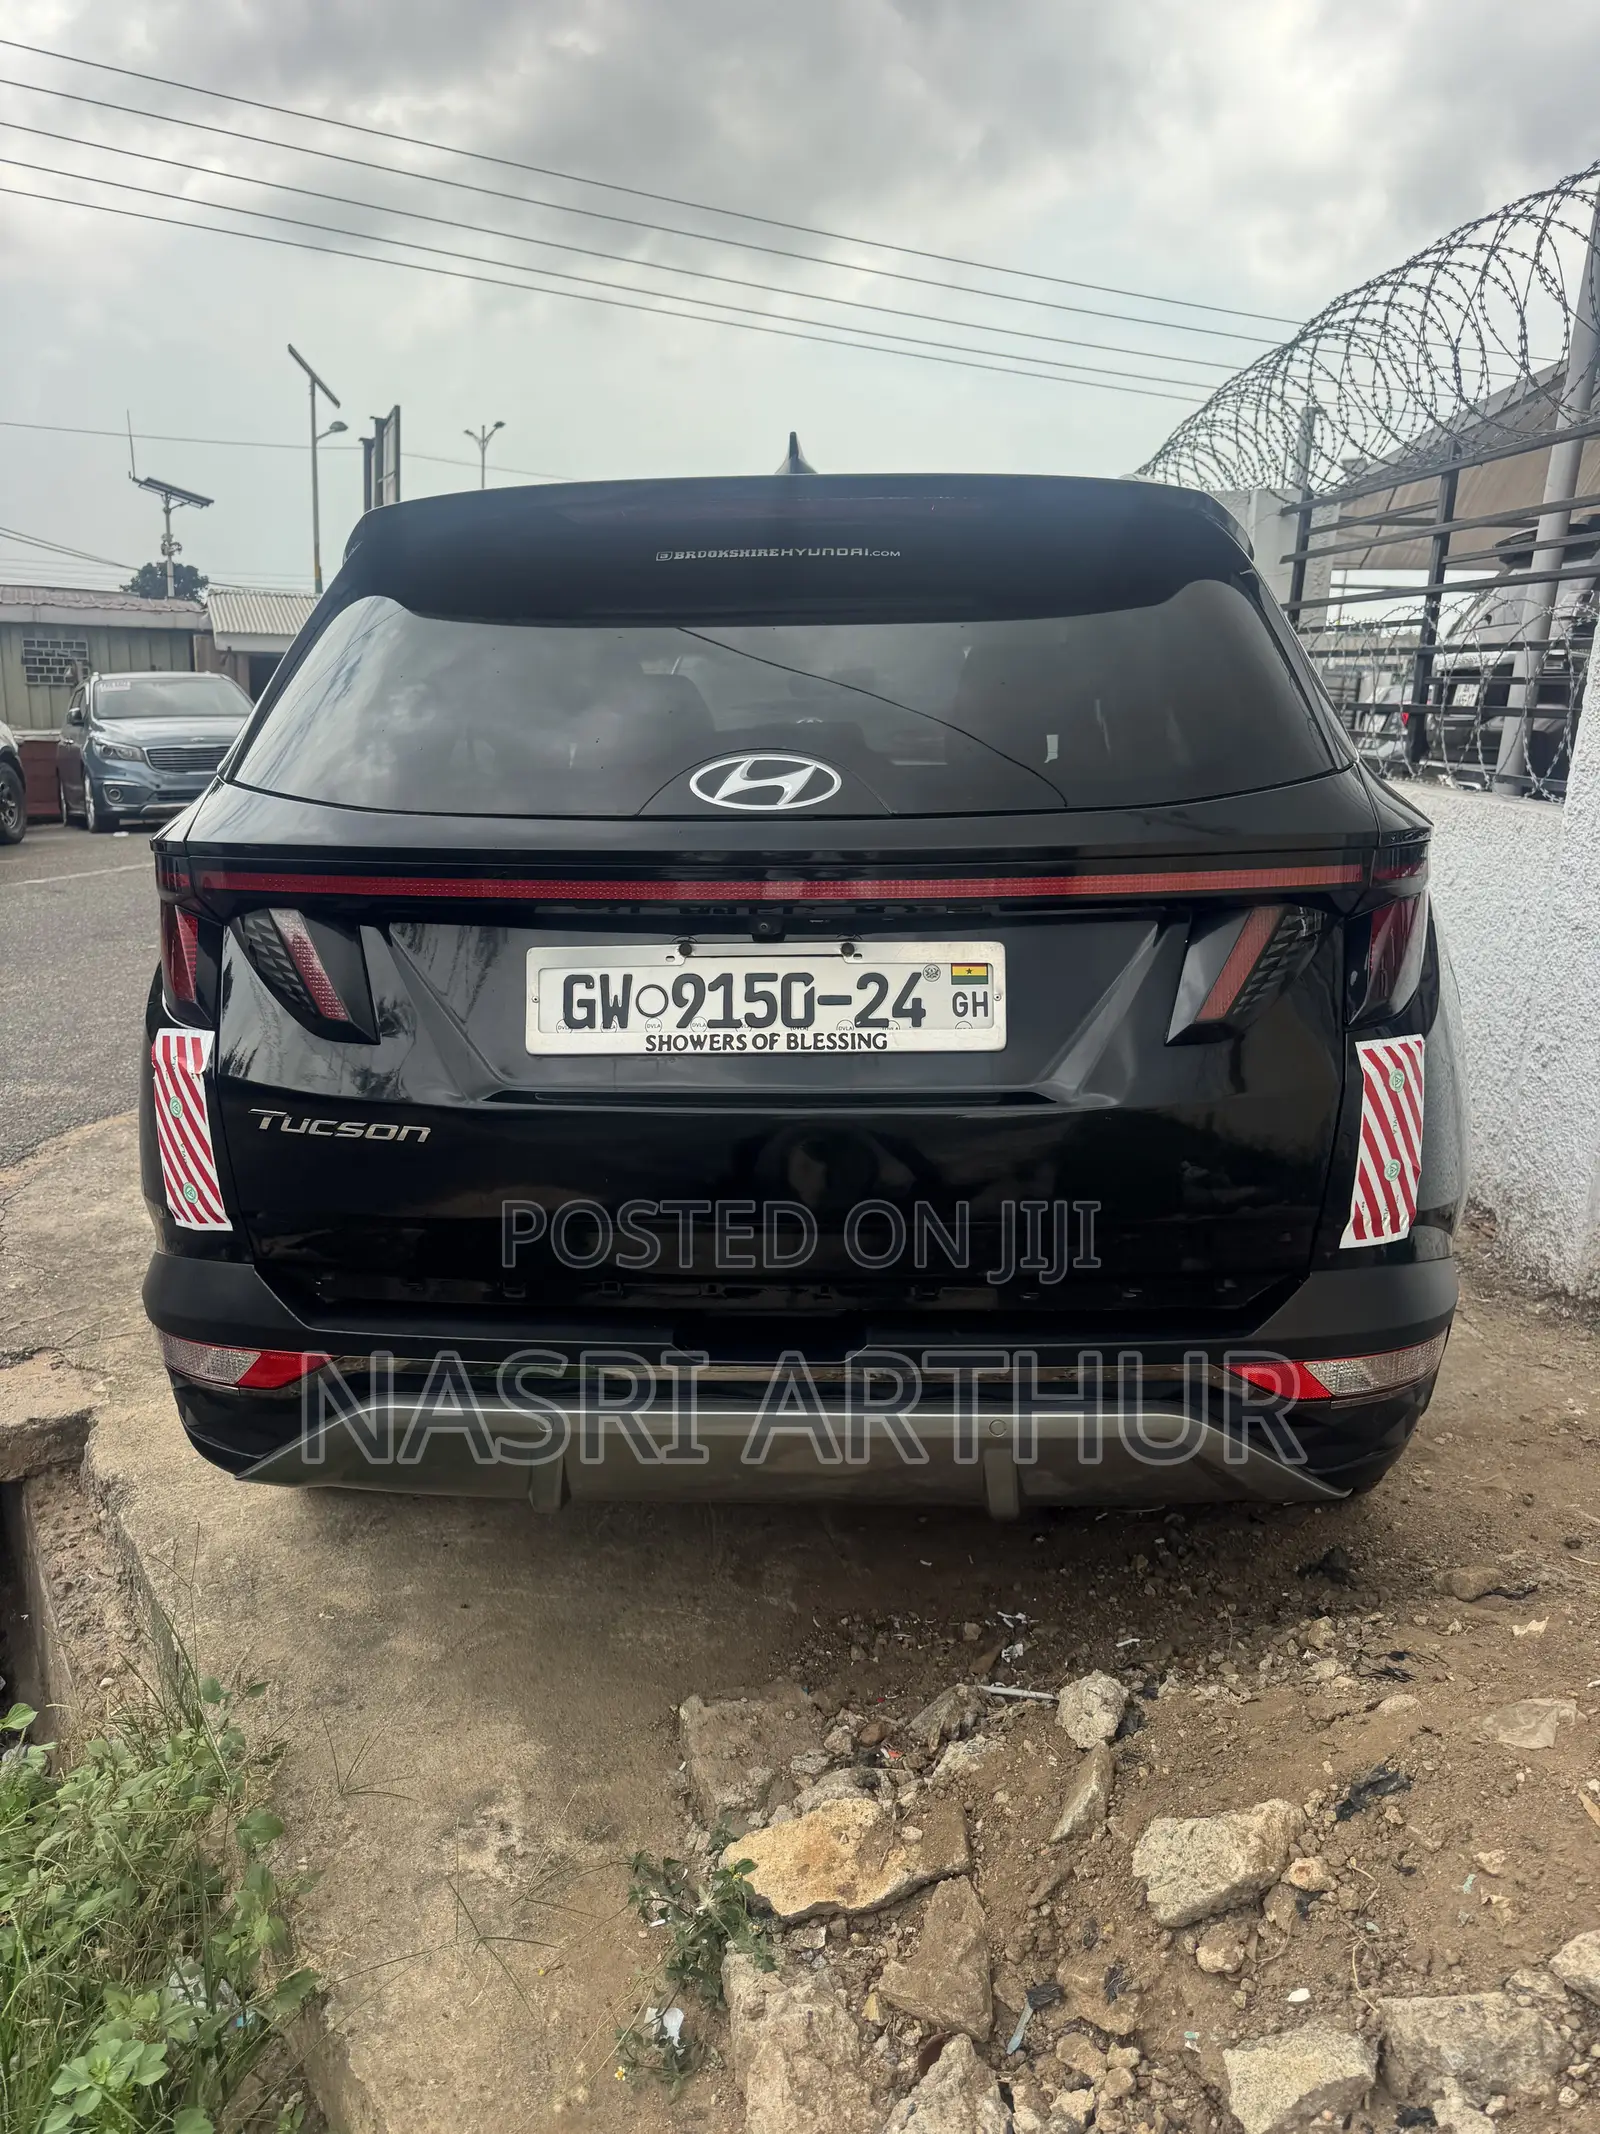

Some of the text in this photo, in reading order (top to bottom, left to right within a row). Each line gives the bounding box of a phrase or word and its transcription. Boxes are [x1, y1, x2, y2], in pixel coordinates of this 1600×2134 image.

[563, 972, 926, 1029] GW 9150-24
[952, 991, 988, 1018] GH
[645, 1033, 888, 1052] SHOWERS OF BLESSING
